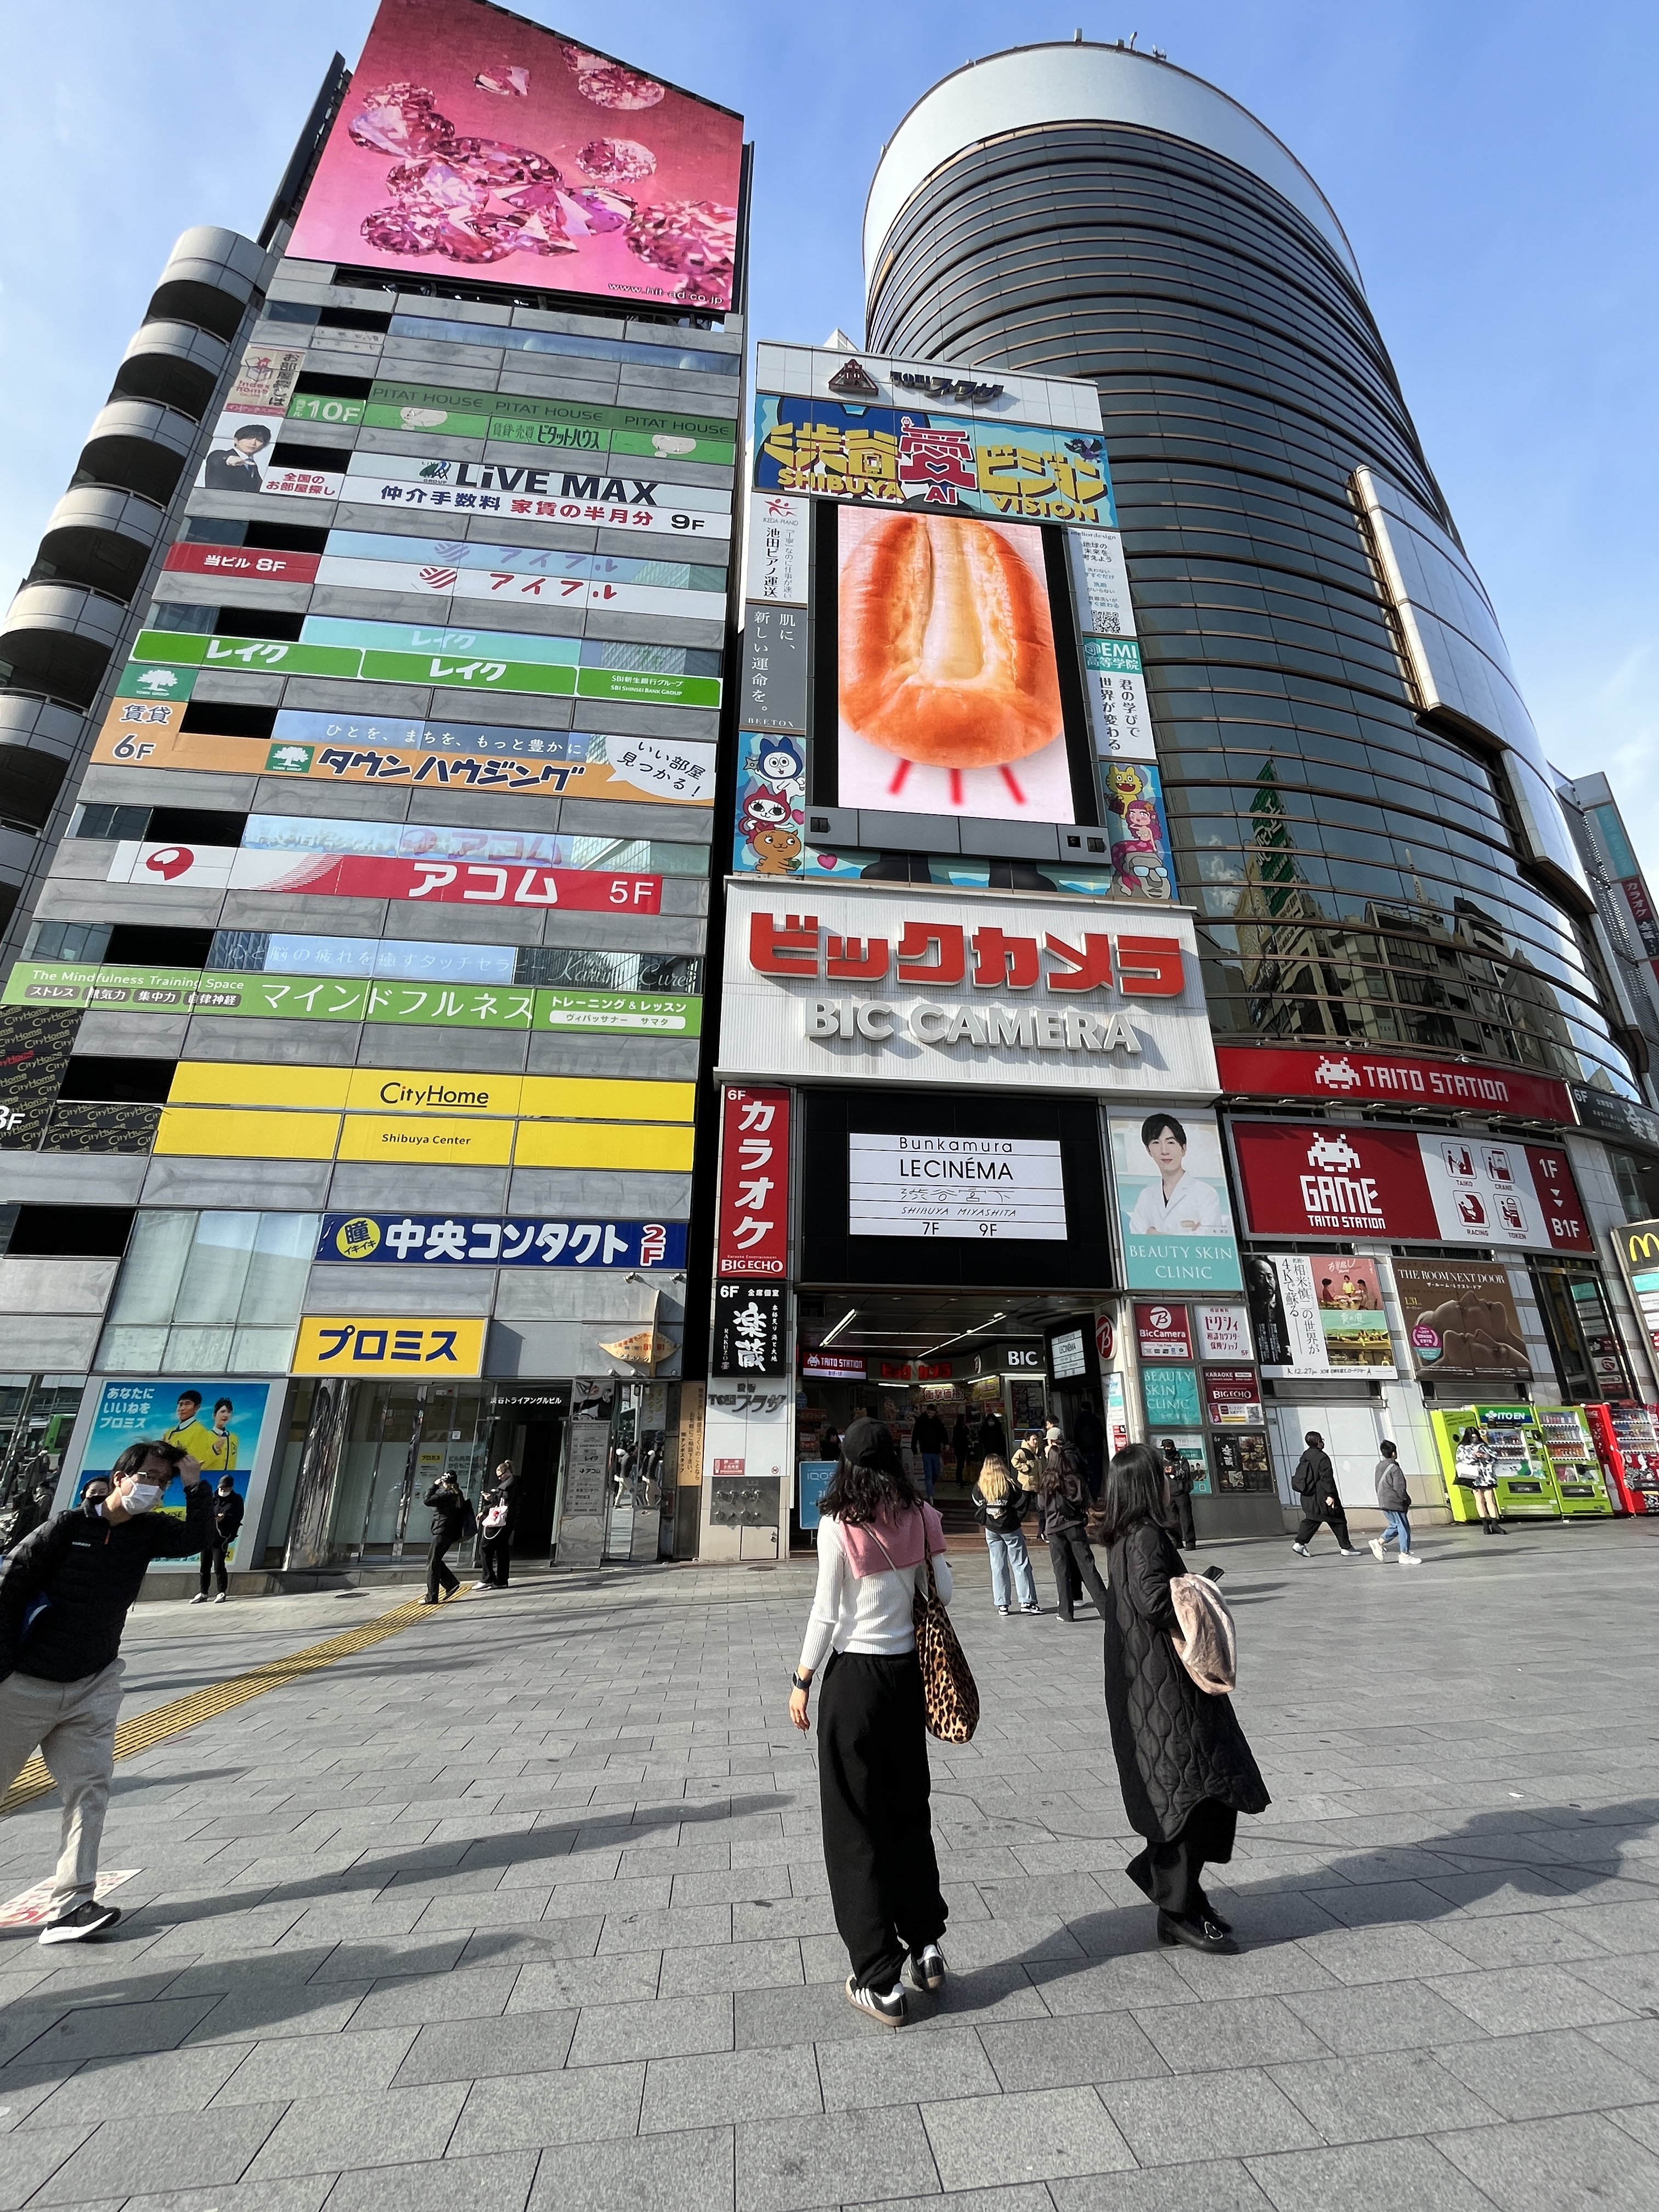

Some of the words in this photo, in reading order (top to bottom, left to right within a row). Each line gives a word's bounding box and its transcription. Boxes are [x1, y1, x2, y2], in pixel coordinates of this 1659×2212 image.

[373, 387, 419, 401] PITAT
[423, 393, 483, 408] HOUSE
[307, 400, 360, 422] 10F
[496, 401, 542, 414] PITAT
[545, 407, 603, 421] HOUSE
[625, 415, 668, 428] PITAT
[673, 421, 729, 436] HOUSE
[538, 425, 600, 449] ピタットハウス
[283, 472, 325, 484] 全国の
[777, 468, 906, 500] SHIBUYA
[266, 481, 336, 496] お部屋探し
[560, 475, 659, 506] MAX
[927, 486, 957, 505] AI
[381, 486, 500, 511] 仲介手数料
[510, 498, 653, 526] 家賃の半月分
[671, 514, 704, 531] 9F
[991, 493, 1099, 523] VISION
[204, 554, 251, 569] 当ビル
[256, 558, 287, 573] 8F
[498, 546, 619, 573] アイフル
[763, 527, 780, 598] 池田ピアノ運送
[489, 573, 618, 600] アイフル
[206, 640, 290, 664] レイク
[1101, 641, 1137, 659] EMI
[429, 658, 507, 682] レイク
[751, 610, 770, 713] 新しい運命を。
[1086, 654, 1141, 671] 高等学院
[612, 675, 685, 687] SBI新生銀行グループ
[118, 704, 172, 726] 賃貸
[1099, 676, 1121, 751] 世界が変わる
[1119, 678, 1141, 738] 君の学びで
[112, 733, 157, 761] 6F
[317, 747, 586, 793] タウンハウジング
[638, 741, 706, 780] いい部屋
[408, 862, 558, 905] アコム
[608, 881, 654, 905] 5F
[748, 911, 1185, 998] ビックカメラ
[32, 970, 58, 982] The
[61, 971, 144, 985] Mindfulness
[149, 975, 203, 990] Training
[205, 979, 245, 990] Space
[30, 987, 74, 997] ストレス
[137, 990, 176, 1003] 集中力
[261, 984, 533, 1021] マインドフルネス
[566, 1013, 629, 1023] ヴィパッサナー
[640, 1017, 669, 1026] サマタ
[805, 998, 894, 1041] BIC
[908, 1002, 1142, 1054] CAMERA
[1362, 1064, 1425, 1092] TAITO
[1429, 1071, 1510, 1103] STATION
[379, 1082, 490, 1108] CityHome
[727, 1090, 747, 1101] 6F
[1573, 1088, 1588, 1103] 6F
[381, 1133, 430, 1146] Shibuya
[432, 1135, 471, 1146] Center
[899, 1137, 1013, 1153] Bunkamura
[732, 1101, 776, 1250] カラオケ
[1539, 1158, 1558, 1178] 1F
[1299, 1173, 1384, 1215] GAME
[901, 1207, 949, 1216] SHIBUYA
[957, 1209, 1016, 1217] MIYASHITA
[1307, 1214, 1342, 1229] TAITO
[1342, 1215, 1387, 1230] STATION
[345, 1220, 370, 1244] 瞳
[922, 1222, 939, 1235] 7F
[979, 1223, 997, 1237] 9F
[1551, 1217, 1581, 1238] B1F
[343, 1239, 377, 1255] イキイキ
[385, 1218, 629, 1265] 中央コンタクト
[1129, 1244, 1190, 1259] BEAUTY
[1196, 1246, 1232, 1260] SKIN
[721, 1259, 746, 1272] BIG
[747, 1259, 783, 1273] ECHO
[1155, 1265, 1214, 1279] CLINIC
[1397, 1269, 1420, 1279] THE
[1421, 1271, 1449, 1282] ROOM
[1449, 1272, 1476, 1283] NEXT
[1477, 1274, 1505, 1284] DOOR
[720, 1285, 740, 1298] 6F
[1293, 1263, 1320, 1355] 相米慎二の世界が
[318, 1324, 458, 1362] プロミス
[732, 1301, 768, 1372] 楽蔵
[1139, 1329, 1186, 1338] BicCamera
[821, 1357, 837, 1367] TAITO
[839, 1358, 862, 1369] STATION
[1008, 1351, 1038, 1365] BIC
[1144, 1371, 1192, 1382] BEAUTY
[106, 1386, 154, 1400] あなたに
[1146, 1385, 1176, 1396] SKIN
[1212, 1390, 1229, 1399] BIG
[1229, 1390, 1252, 1399] ECHO
[103, 1401, 151, 1414] いいねを
[1147, 1399, 1190, 1410] CLINIC
[99, 1416, 146, 1429] プロミス
[1497, 1412, 1514, 1420] ITO
